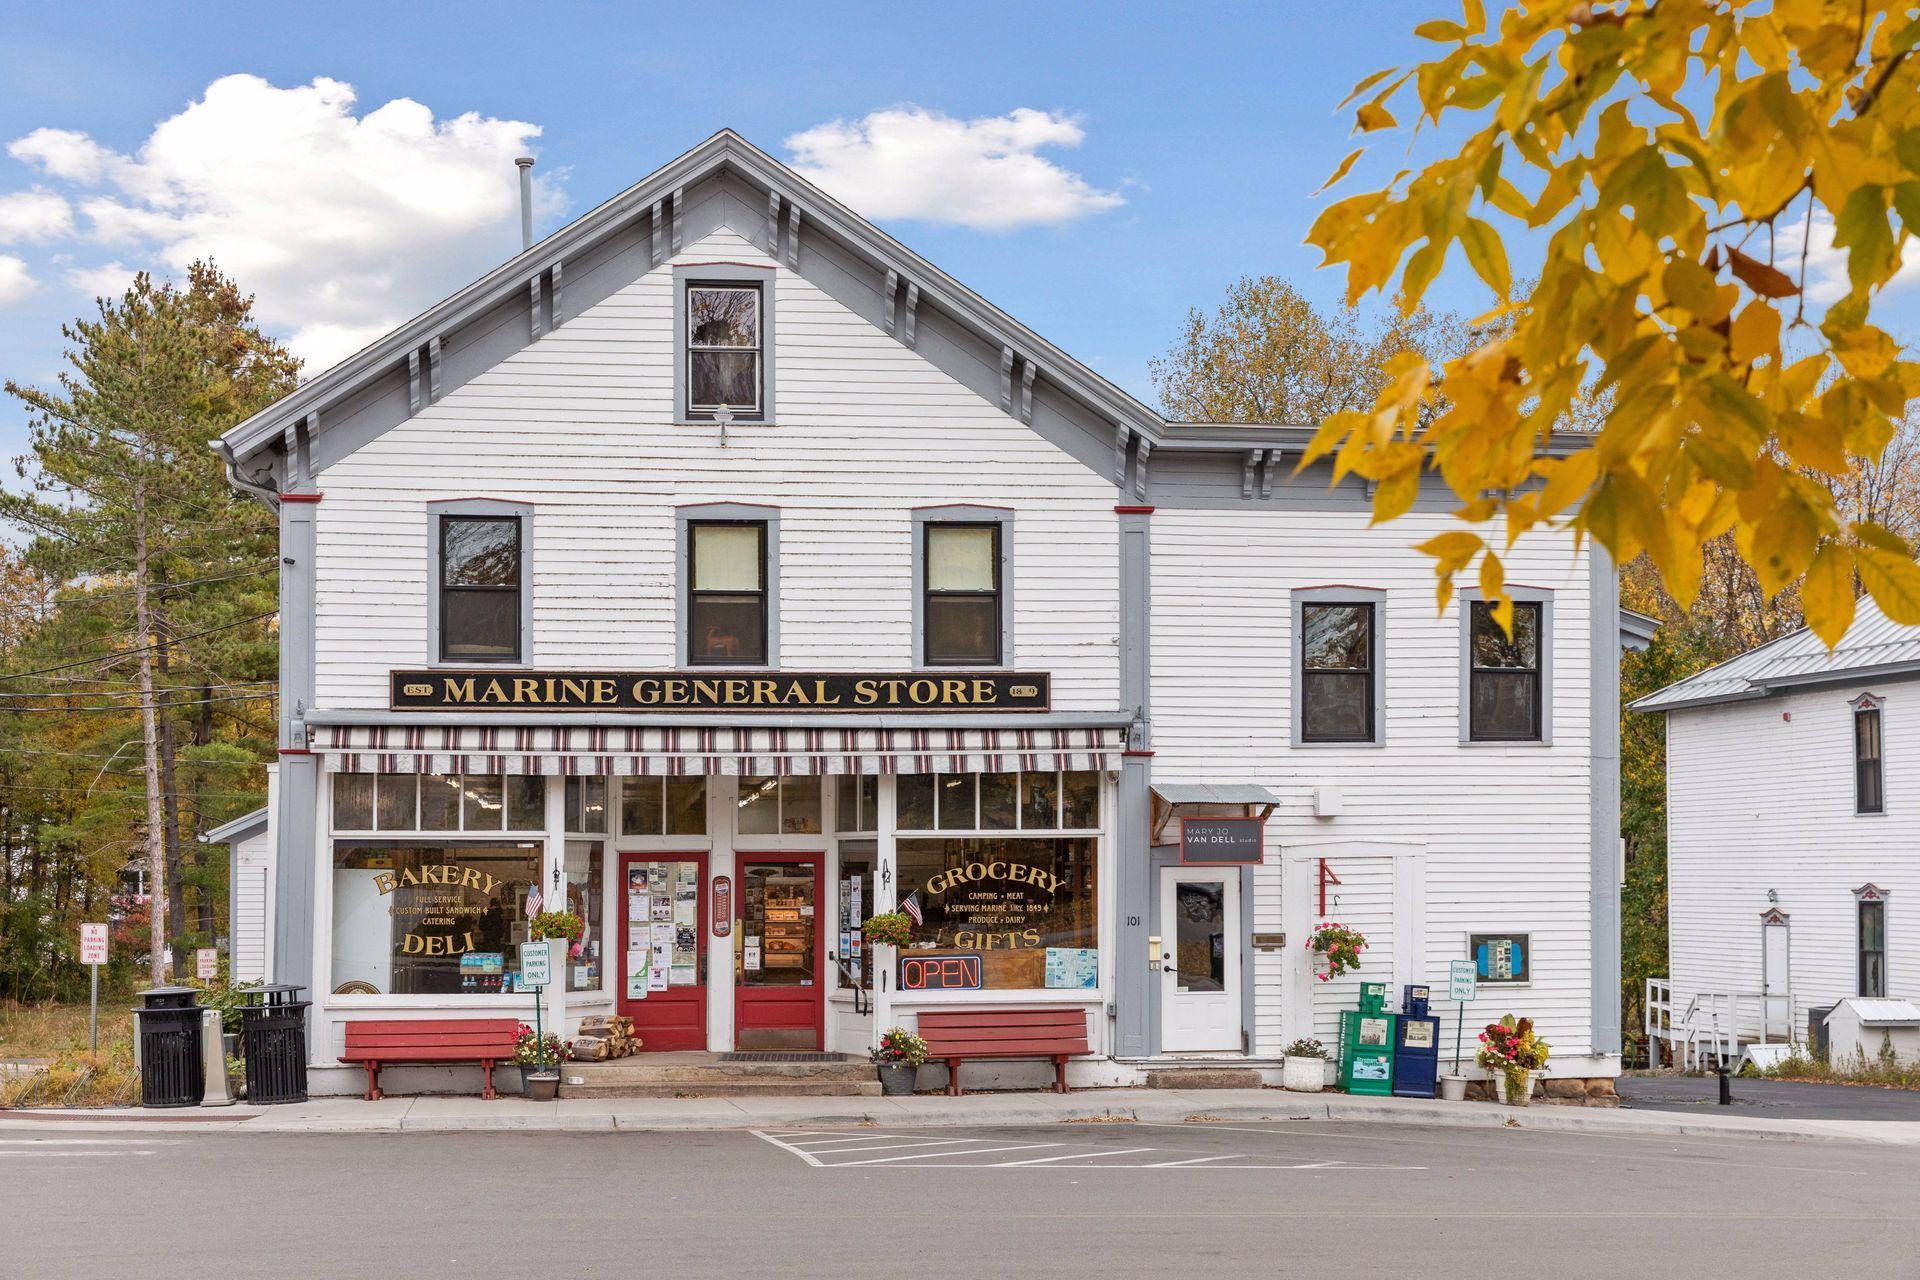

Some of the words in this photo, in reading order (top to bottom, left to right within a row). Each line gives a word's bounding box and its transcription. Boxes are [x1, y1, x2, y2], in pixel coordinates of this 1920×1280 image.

[407, 686, 431, 694] EST.
[442, 678, 619, 703] MARINE
[632, 679, 841, 704] GENERAL
[853, 679, 998, 705] STORE
[1012, 687, 1036, 696] 189
[1186, 827, 1214, 835] MARY
[1217, 827, 1229, 835] JO
[1186, 836, 1207, 844] VAN
[1211, 836, 1236, 844] DELL
[372, 864, 503, 896] BAKERY
[926, 861, 1067, 895] GROCERY
[415, 895, 432, 904] FULL
[434, 895, 462, 904] SERVICE
[968, 892, 998, 900] CAMPING
[1006, 892, 1024, 900] MEAT
[396, 906, 423, 915] CUSTOM
[425, 906, 443, 915] BUILT
[445, 906, 481, 915] SANDWICH
[951, 904, 980, 912] SERVING
[981, 904, 1007, 912] MARINE
[422, 917, 456, 926] CATERING
[968, 916, 998, 924] PRODUCE
[1005, 916, 1026, 924] DAIRY
[1127, 917, 1140, 927] 101
[402, 931, 476, 956] DELI
[954, 928, 1041, 951] GIFTS
[523, 949, 547, 957] CUSTOMER
[527, 971, 545, 979] ONLY
[904, 960, 979, 989] OPEN
[1454, 987, 1471, 995] ONLY
